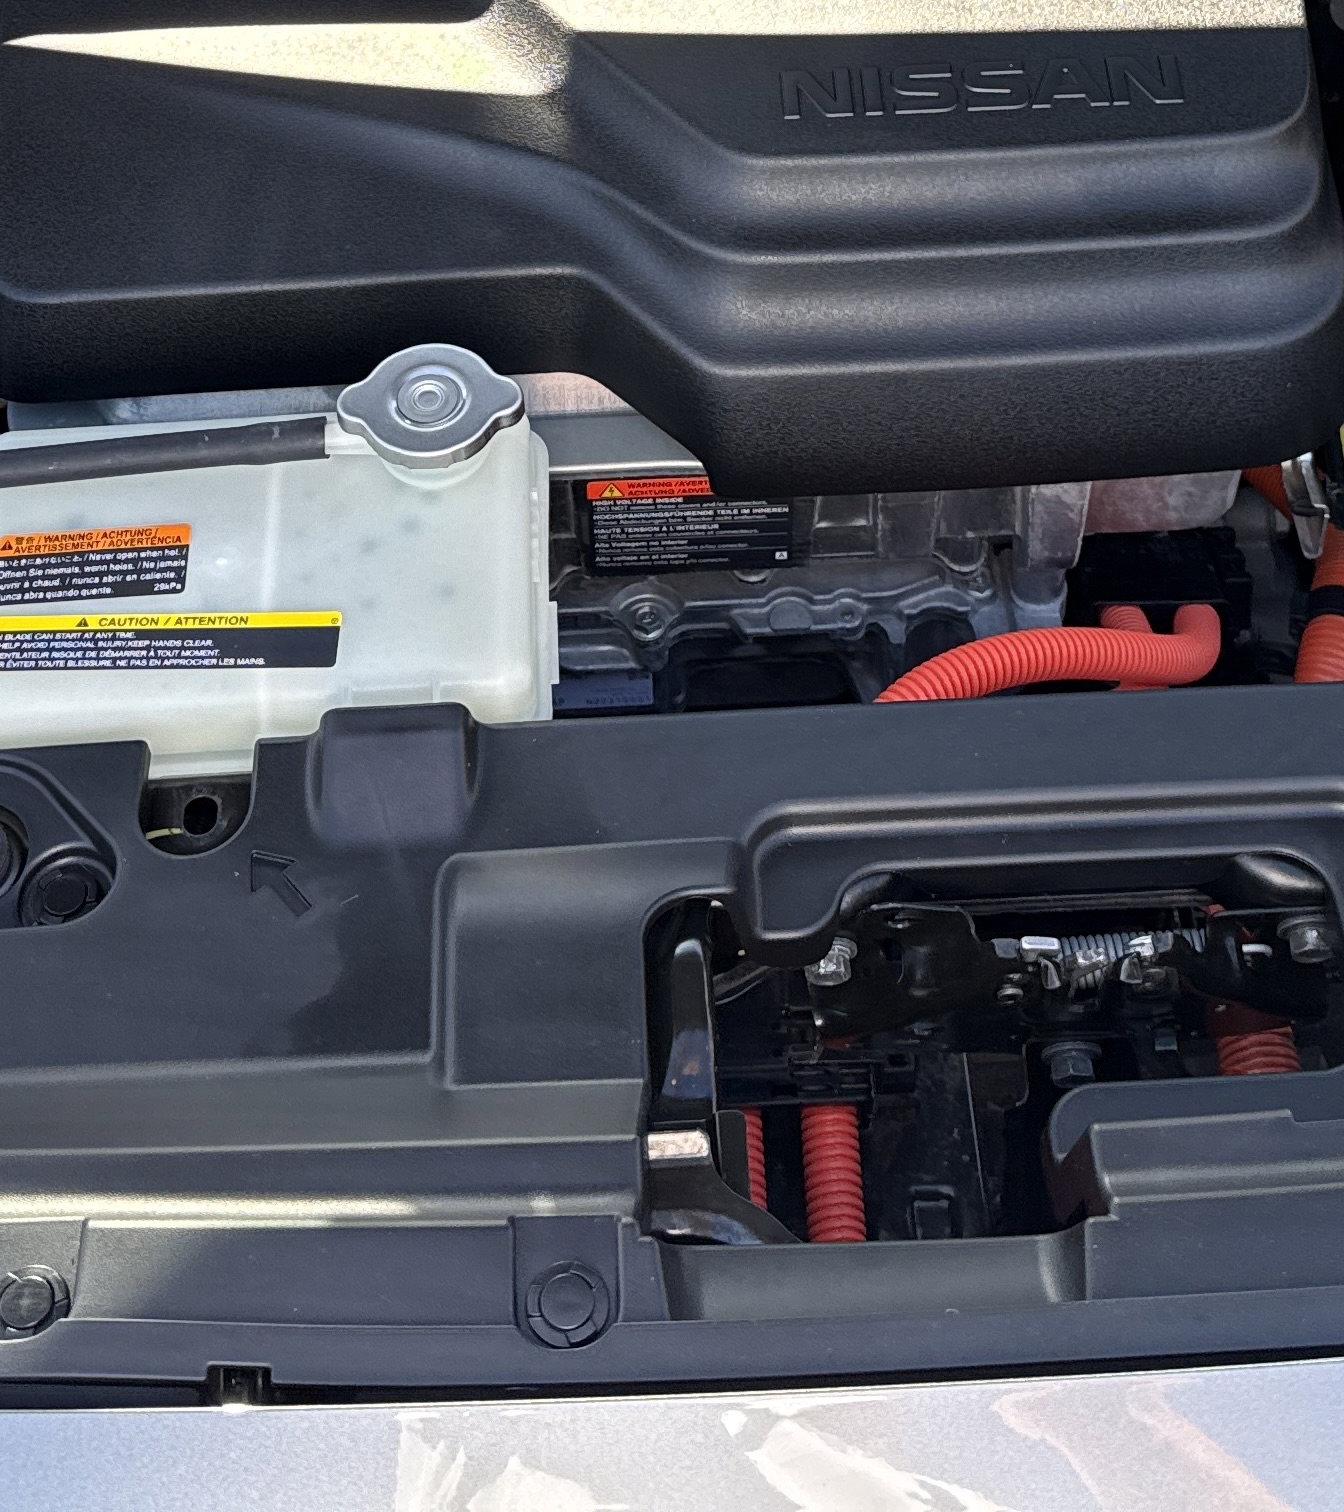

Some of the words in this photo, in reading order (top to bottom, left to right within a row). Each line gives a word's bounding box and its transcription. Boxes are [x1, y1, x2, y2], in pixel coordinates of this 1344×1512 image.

[779, 54, 1185, 120] NISSAN
[627, 481, 673, 489] WARNING
[44, 532, 93, 544] WARNING
[101, 529, 153, 540] ACHTUNG
[13, 541, 101, 554] AVERTISSEMENT
[89, 553, 115, 561] Never
[116, 552, 138, 561] open
[139, 550, 163, 558] when
[28, 568, 43, 577] Sie
[72, 576, 100, 585] nunca
[102, 575, 123, 583] abrir
[23, 591, 44, 600] abra
[45, 589, 79, 600] quando
[98, 617, 160, 627] CAUTION
[174, 615, 249, 627] ATTENTION
[4, 633, 33, 641] BLADE
[54, 632, 82, 640] START
[21, 641, 48, 649] AVOID
[49, 640, 96, 649] PERSONAL
[151, 639, 182, 648] HANDS
[50, 651, 84, 659] RISQUE
[157, 649, 180, 657] TOUT
[37, 660, 66, 668] TOUTE
[115, 659, 128, 667] NE
[162, 658, 217, 666] APPROCHER
[218, 658, 235, 666] LES
